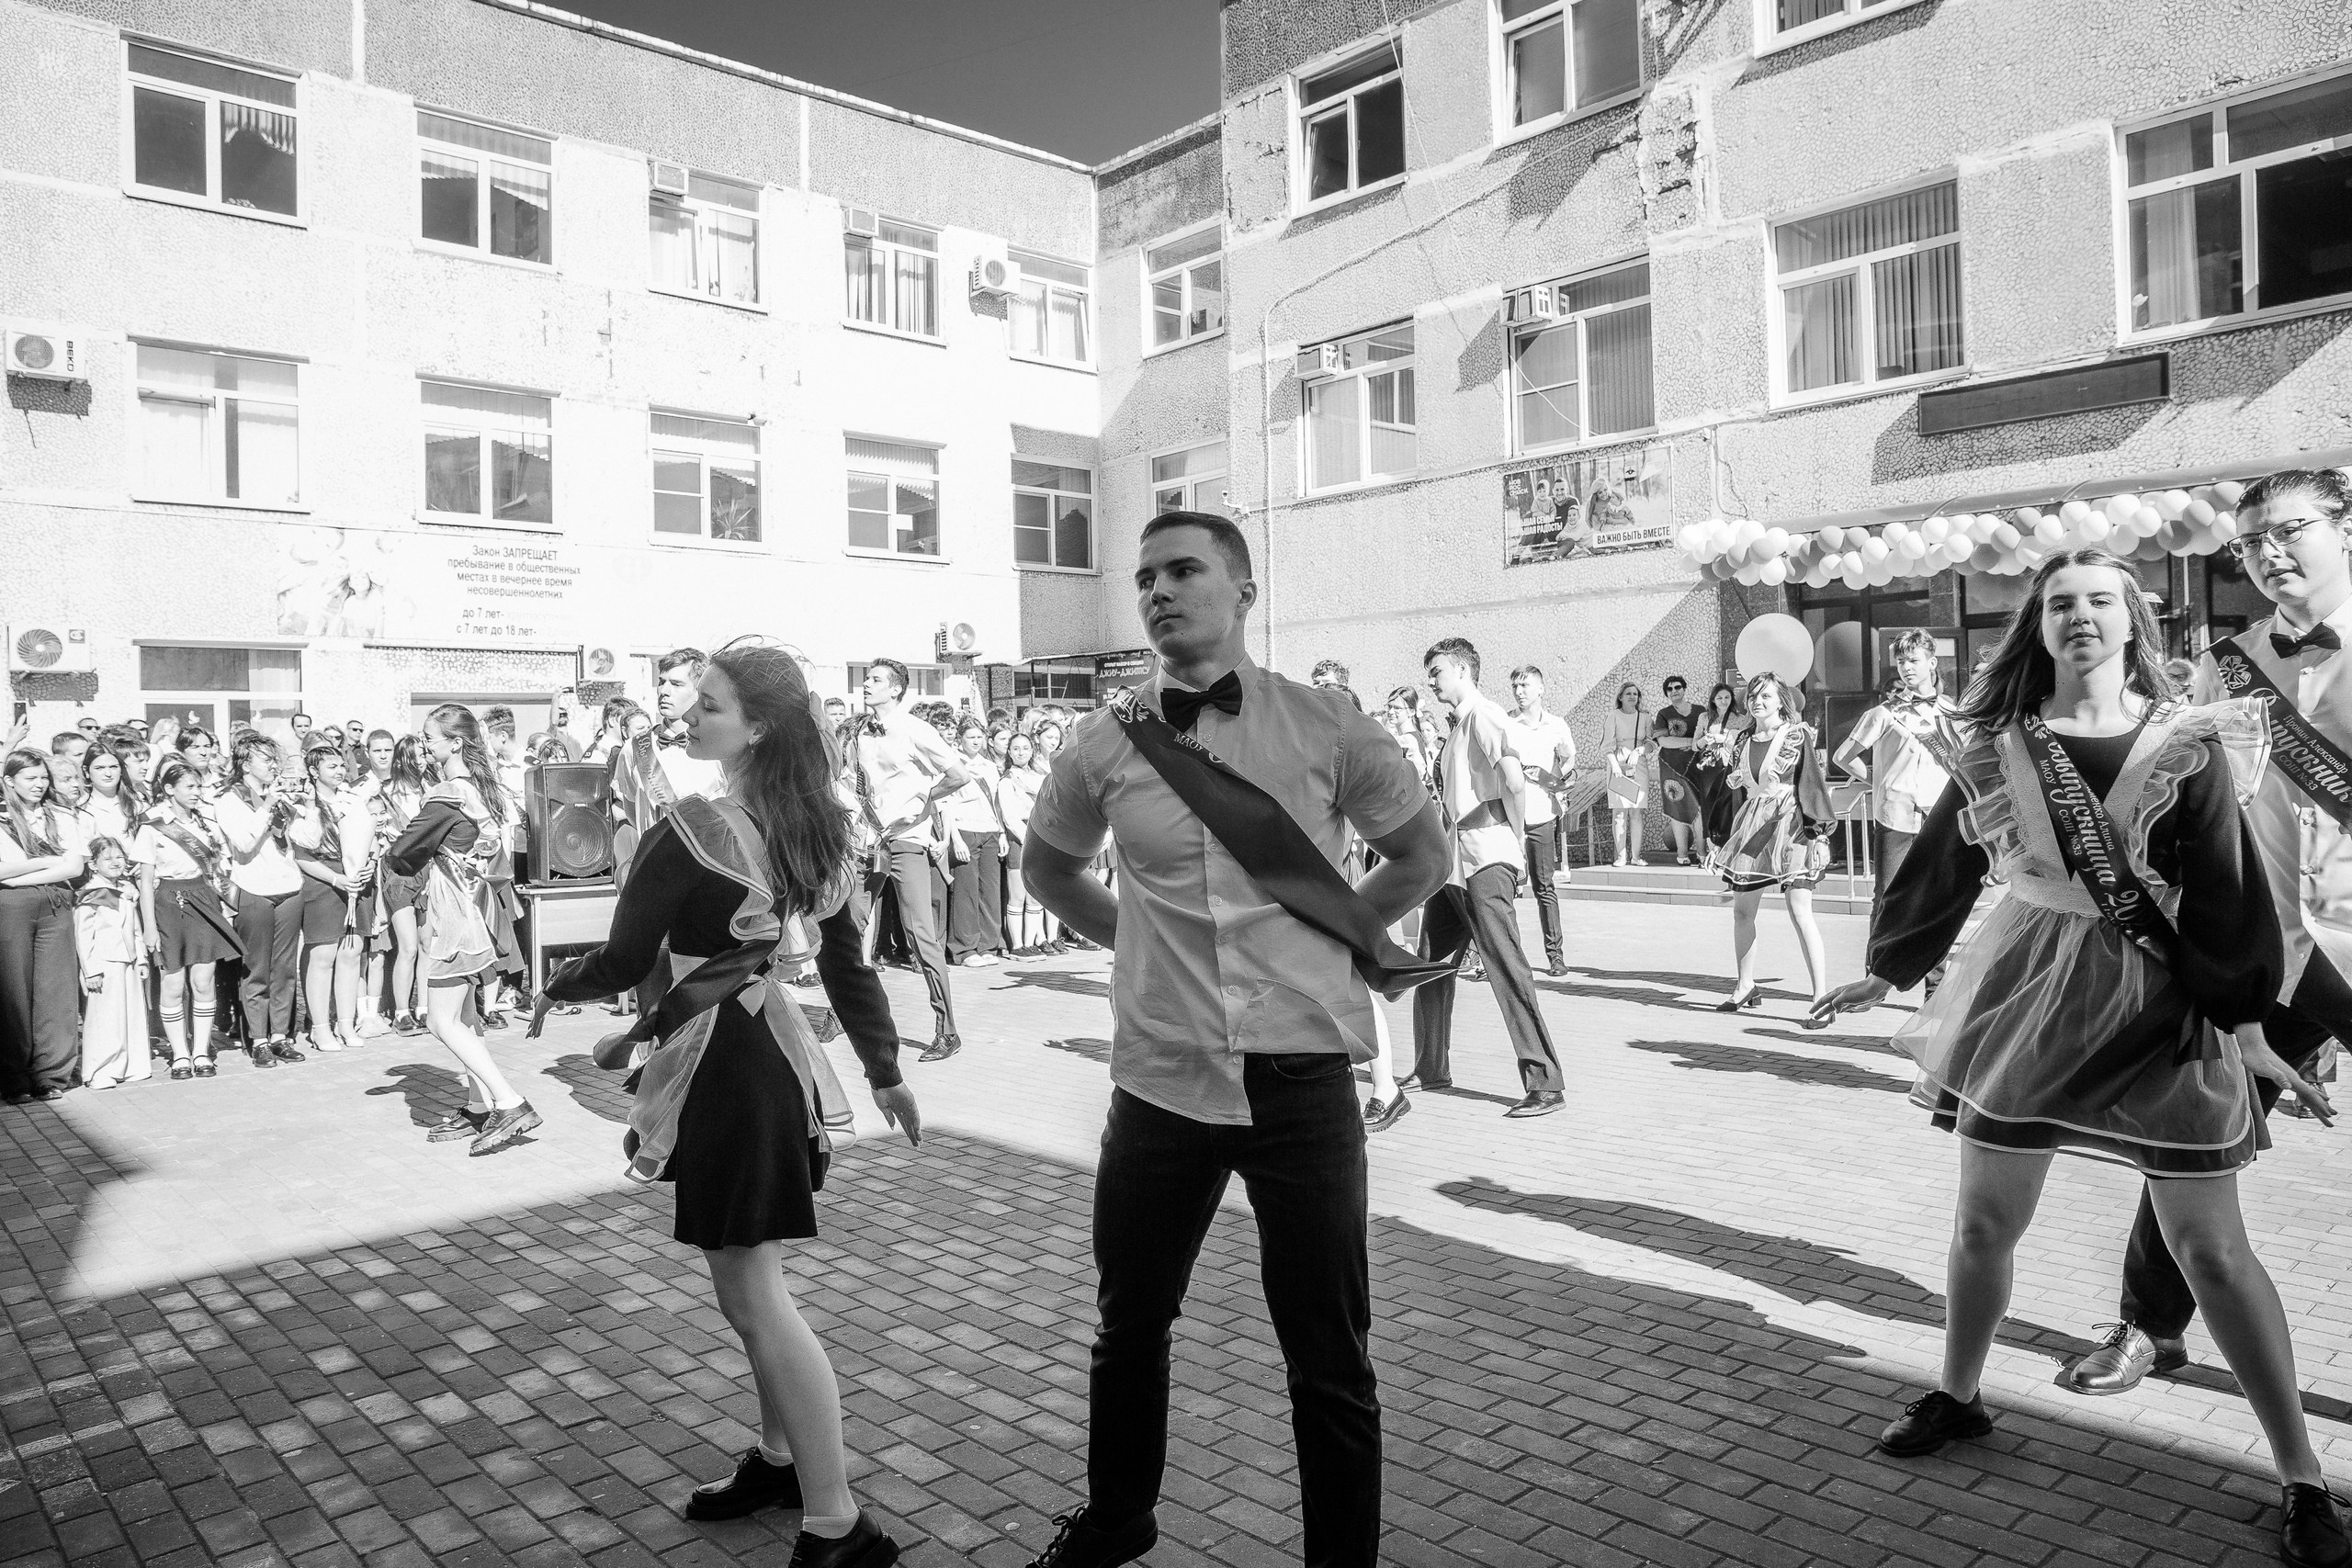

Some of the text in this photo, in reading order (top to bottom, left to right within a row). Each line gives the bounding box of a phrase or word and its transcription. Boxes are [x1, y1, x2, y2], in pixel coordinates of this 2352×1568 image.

[1597, 525, 1671, 545] ВАЖНО БЫТЬ ВМЕСТЕ
[472, 545, 558, 560] Закон ЗАПРЕЩАЕТ
[447, 558, 581, 575] пребывание в общественных
[458, 572, 572, 588] местах в вечернее время
[467, 586, 563, 599] несовершеннолетних
[462, 609, 474, 619] до
[477, 607, 482, 617] 7
[457, 625, 462, 633] с
[465, 623, 469, 634] 7
[472, 626, 488, 635] лет
[491, 626, 503, 637] до
[506, 625, 515, 636] 18
[2283, 715, 2348, 774] Пронин Александр
[2279, 754, 2300, 773] СОШ
[2059, 809, 2075, 833] СОШ
[2098, 820, 2114, 852] Алина
